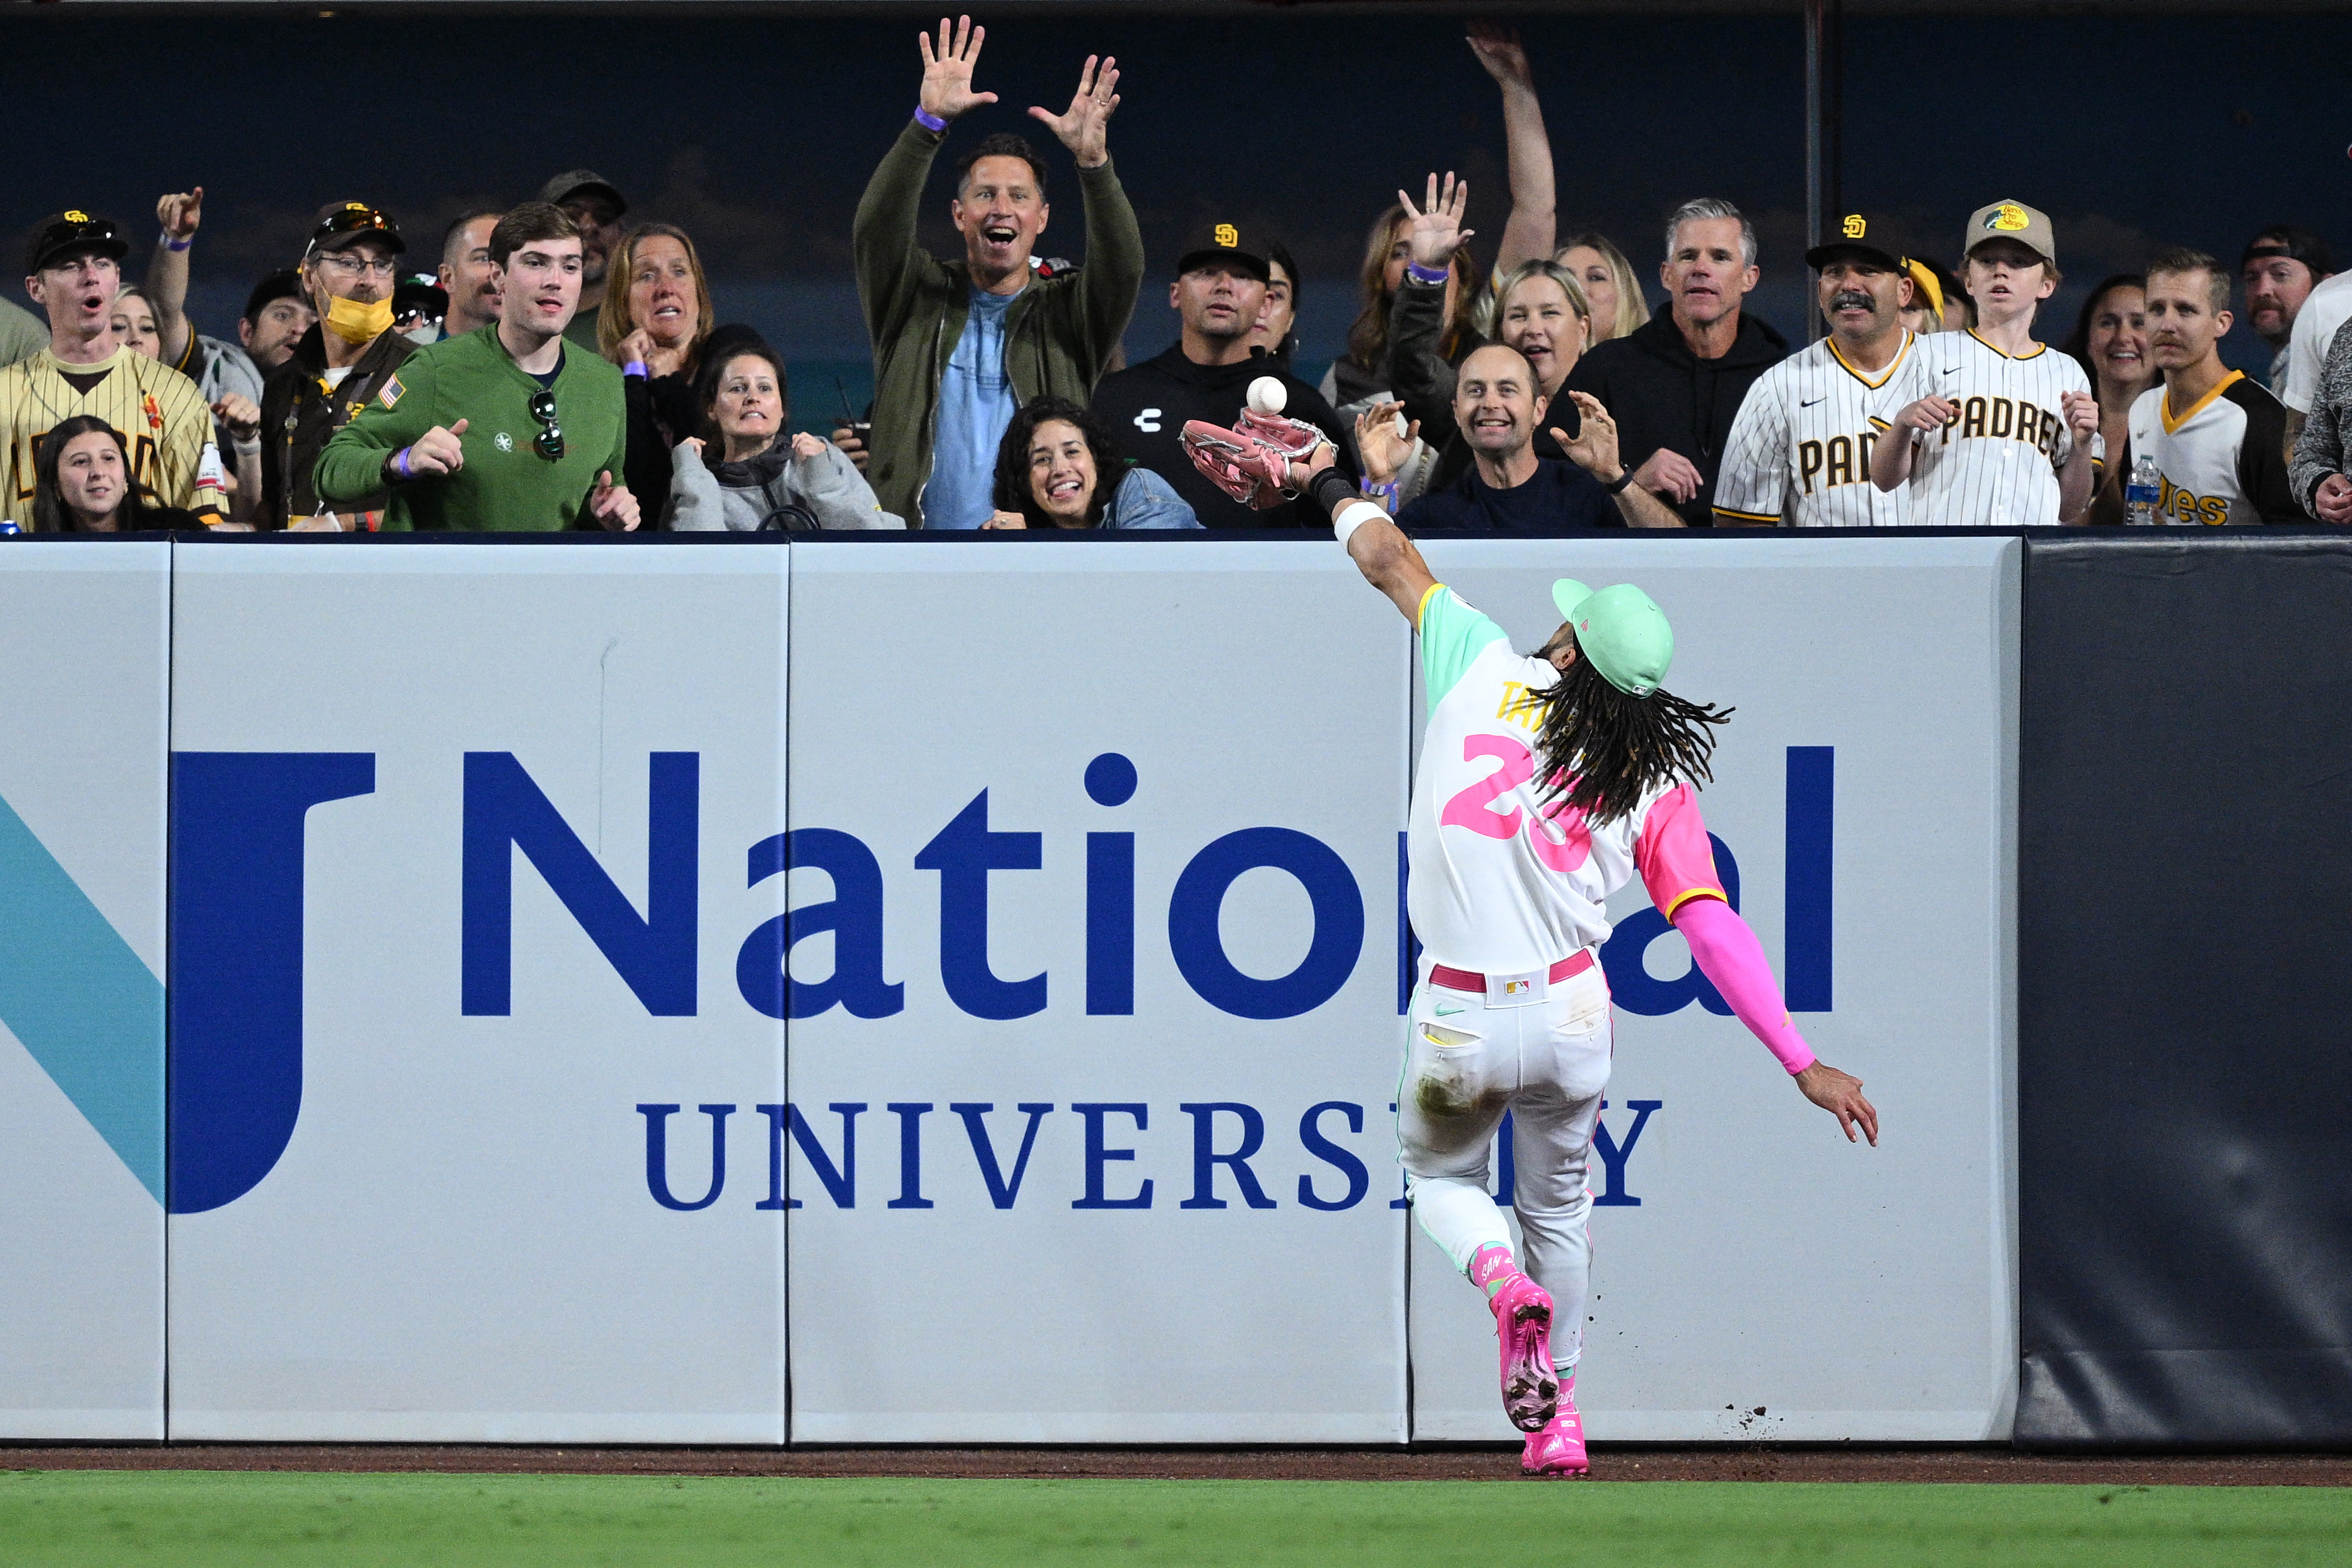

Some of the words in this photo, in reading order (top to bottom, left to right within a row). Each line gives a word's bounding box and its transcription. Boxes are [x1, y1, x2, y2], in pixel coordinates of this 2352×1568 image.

[1215, 223, 1238, 248] SD
[1842, 214, 1866, 238] SD
[1799, 431, 1881, 495] PAD
[461, 746, 1834, 1021] Natioal
[1481, 1255, 1502, 1281] SAN
